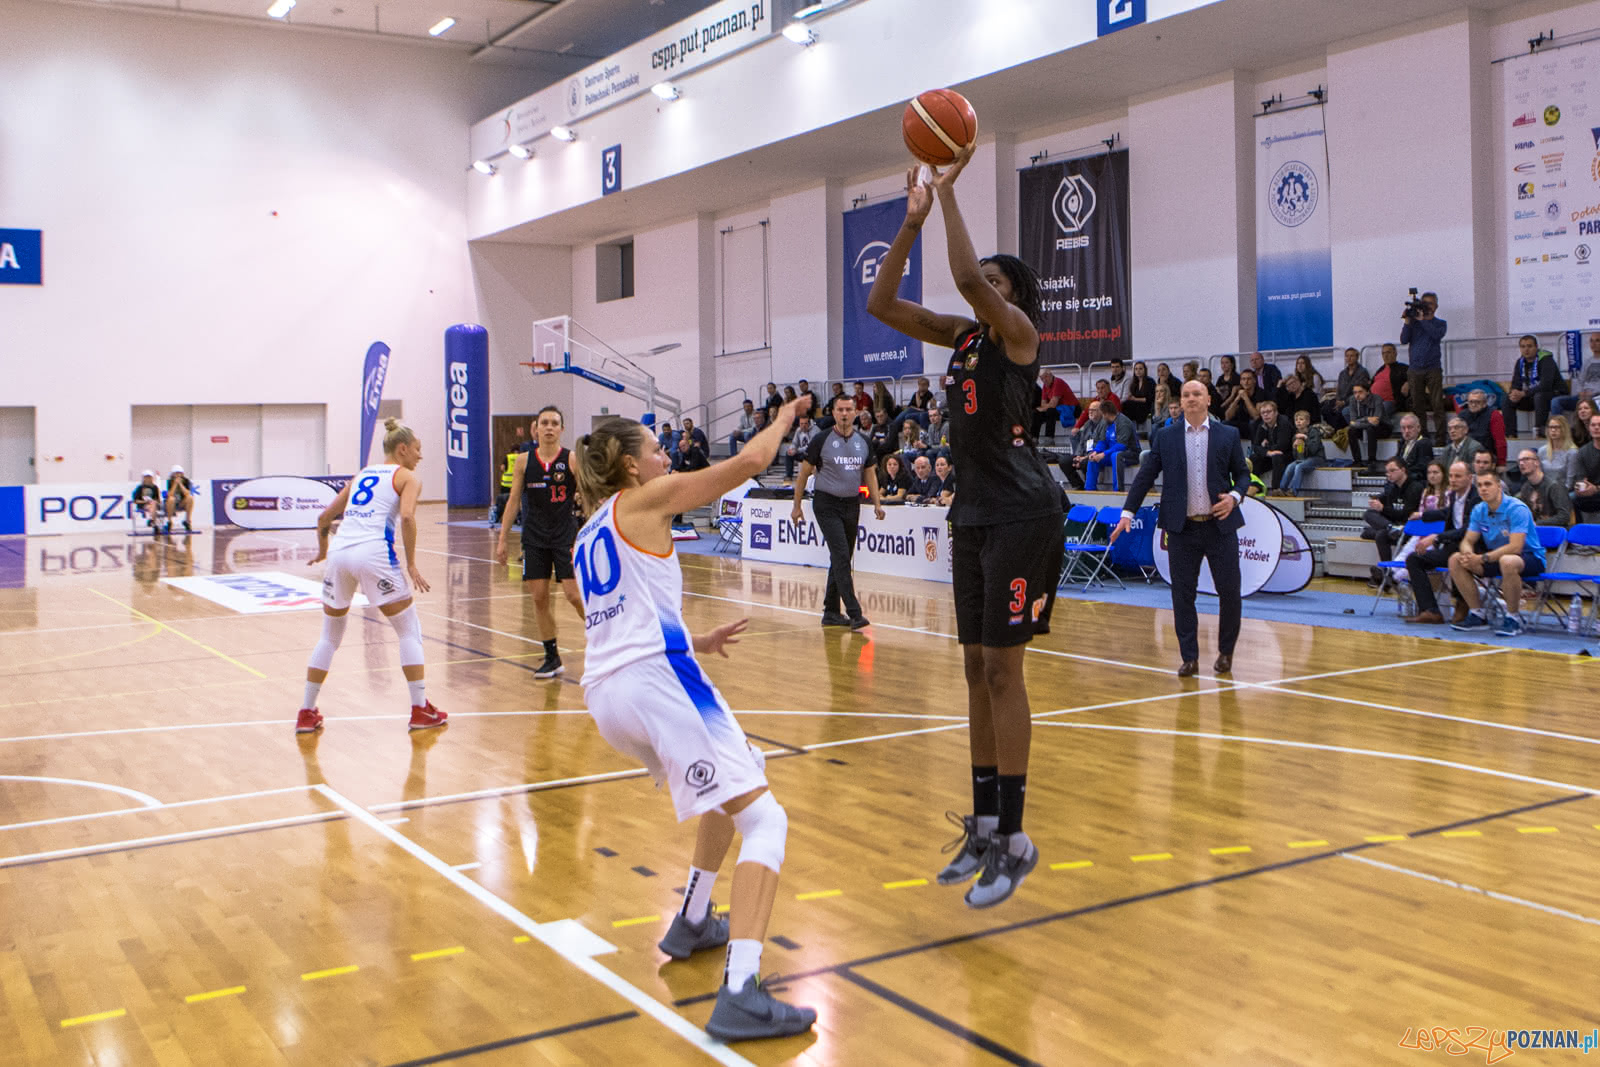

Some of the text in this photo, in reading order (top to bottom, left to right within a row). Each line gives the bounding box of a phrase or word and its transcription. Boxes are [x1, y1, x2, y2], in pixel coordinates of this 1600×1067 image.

[651, 0, 765, 70] cspp.put.poznan.pl
[606, 151, 616, 188] 3
[1056, 235, 1090, 250] REBIS
[862, 257, 911, 284] Ea
[1041, 294, 1112, 312] tóre się czyta
[1040, 325, 1121, 342] w.rebis.com.pl
[864, 347, 908, 363] www.enea.pl
[369, 354, 388, 411] Enea
[448, 362, 469, 459] Enea
[963, 379, 978, 415] 3
[833, 456, 862, 464] VERONI
[352, 476, 380, 506] 8
[550, 485, 567, 502] 13
[778, 519, 818, 546] ENEA
[857, 526, 915, 556] Poznań
[1239, 536, 1256, 548] sket
[574, 526, 621, 605] 10
[1244, 549, 1270, 562] Kobiet
[1010, 578, 1027, 613] 3
